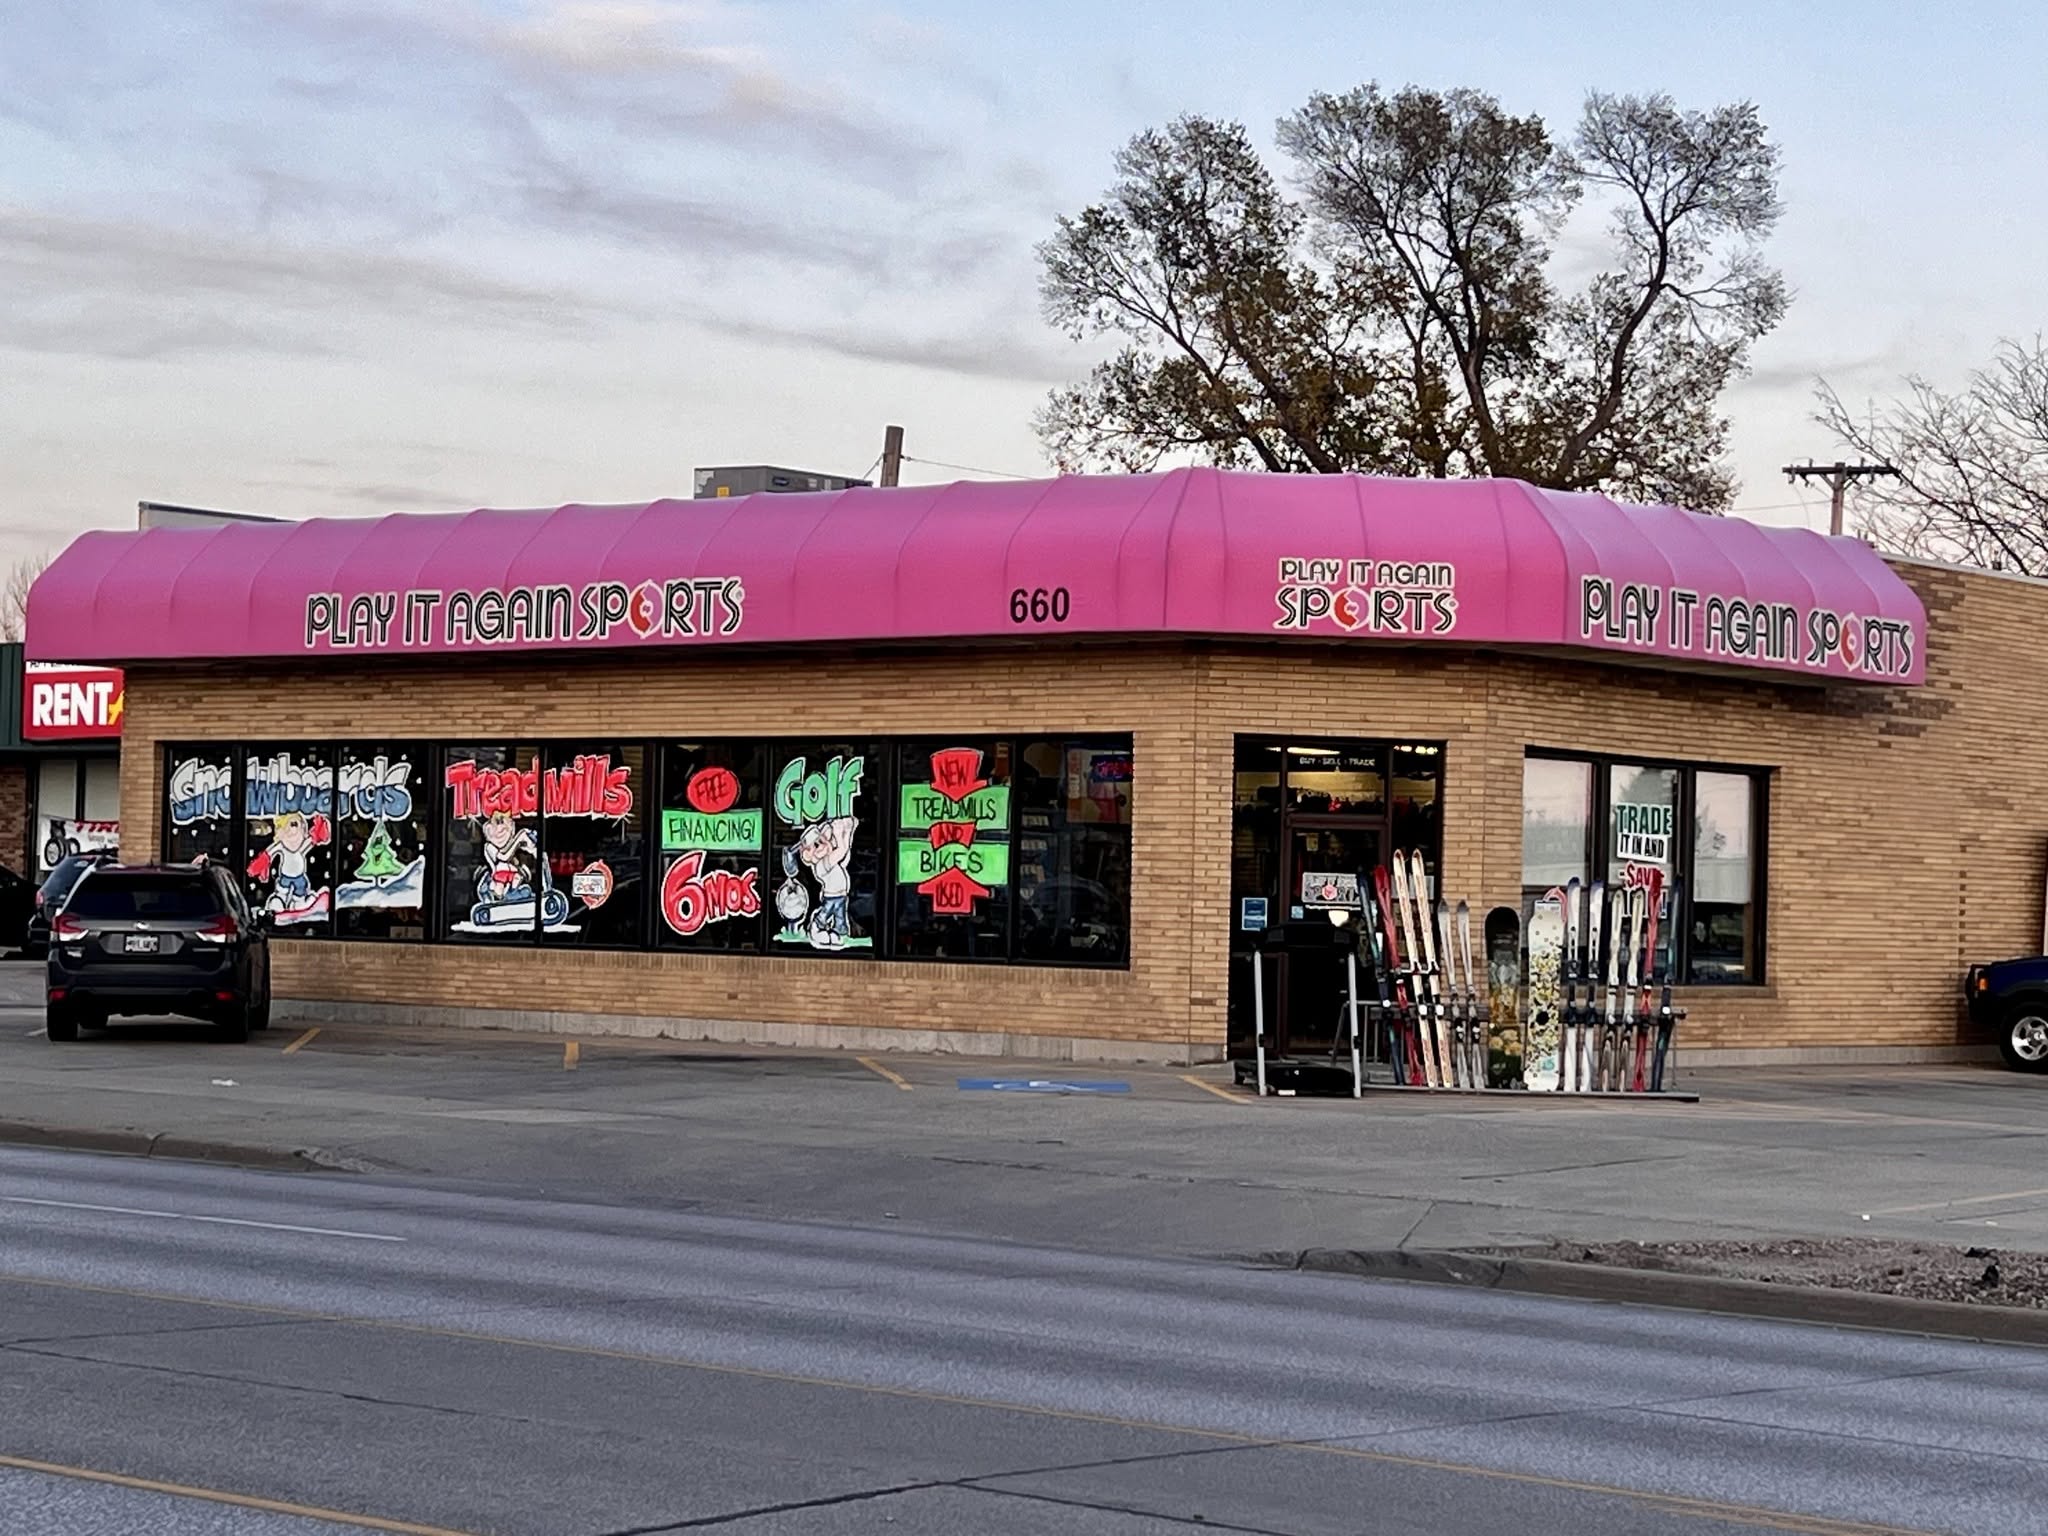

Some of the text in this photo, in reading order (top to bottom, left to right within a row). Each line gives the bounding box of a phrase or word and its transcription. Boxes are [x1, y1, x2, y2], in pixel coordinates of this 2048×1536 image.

[1279, 558, 1454, 589] PLAY IT AGAIN
[305, 578, 743, 646] PLAY IT AGAIN SPORTS
[1010, 587, 1069, 623] 660
[1275, 586, 1457, 634] SPORTS
[1582, 576, 1913, 677] PLAY IT AGAIN SPORTS
[33, 681, 114, 726] RENT
[940, 759, 970, 788] NEW
[774, 755, 864, 829] Golf
[912, 797, 997, 821] TREADMILLS
[1617, 805, 1671, 835] TRADE
[669, 817, 756, 843] FINANCING!
[938, 824, 964, 841] AND
[1620, 834, 1665, 858] IT IN AND
[920, 850, 983, 874] BIKES
[1626, 863, 1664, 889] SAV
[661, 850, 707, 935] 6
[935, 882, 964, 908] USED
